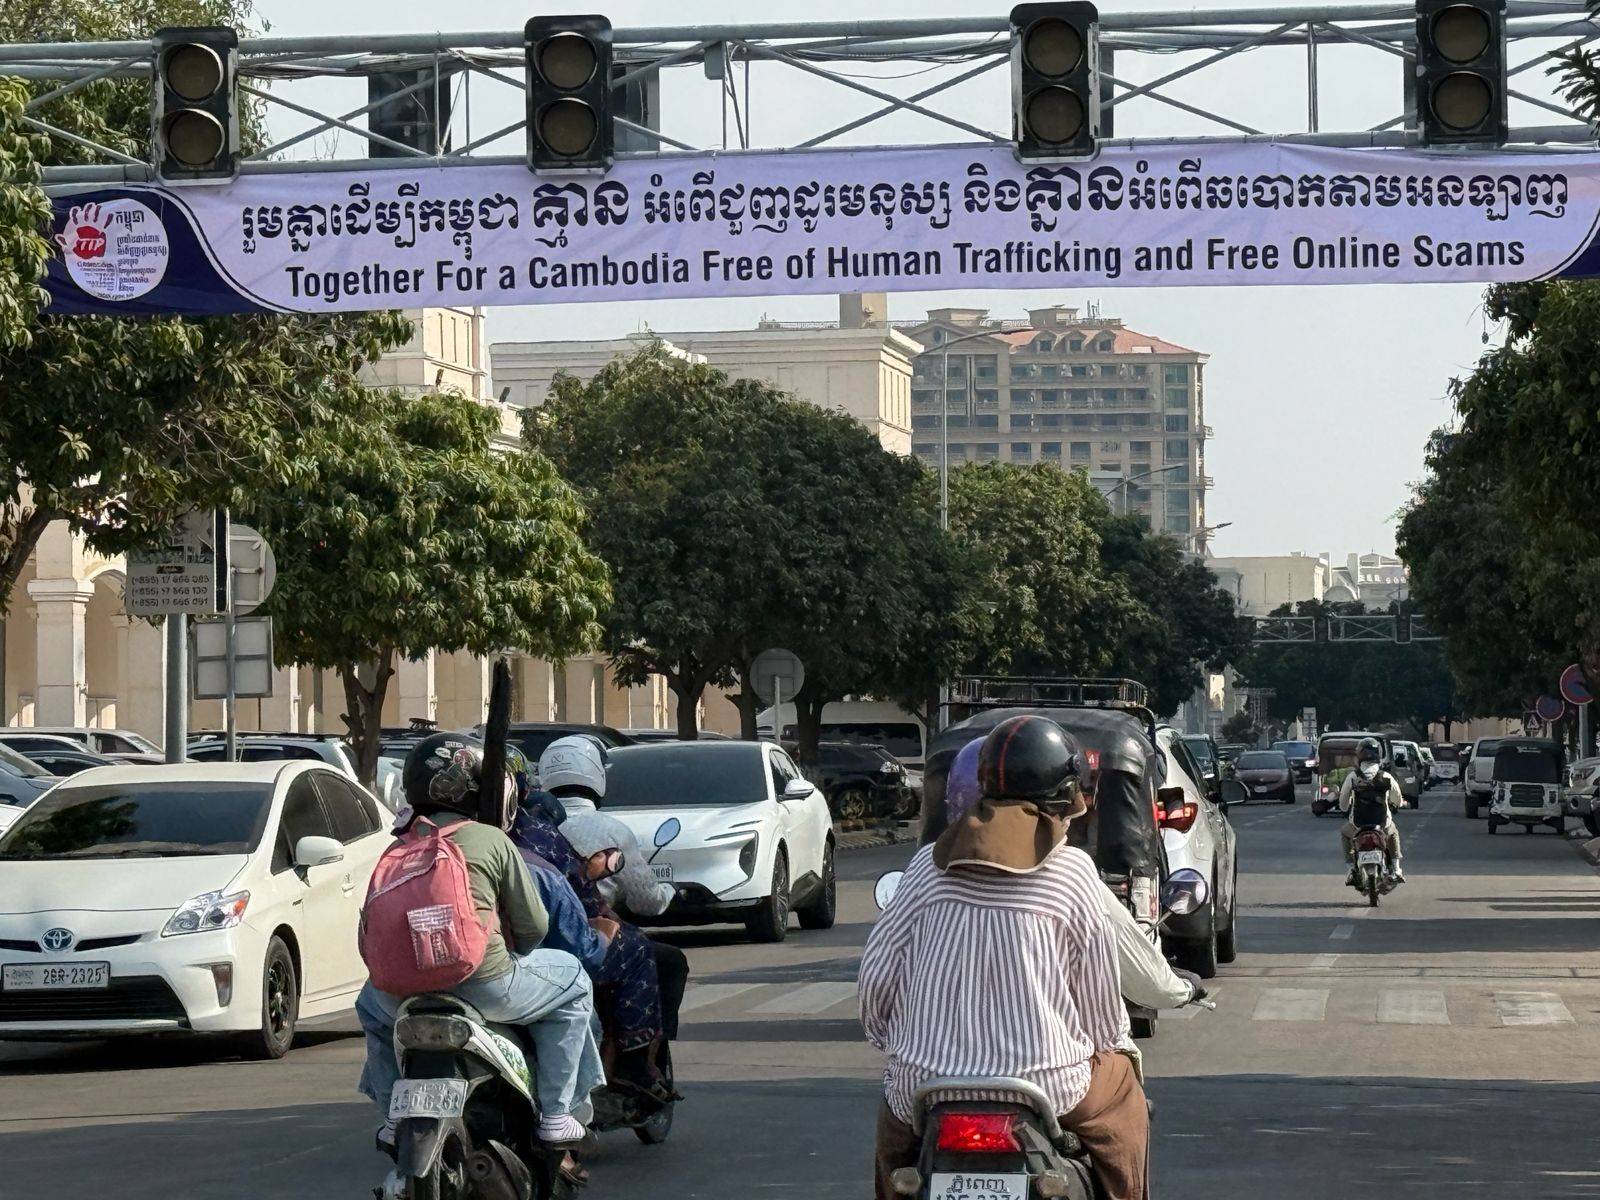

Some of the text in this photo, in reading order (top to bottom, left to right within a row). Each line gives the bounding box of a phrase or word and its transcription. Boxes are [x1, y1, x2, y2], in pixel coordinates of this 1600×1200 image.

[285, 235, 1525, 303] Together For a Cambodia Free of Human Trafficking and Free Online Scams
